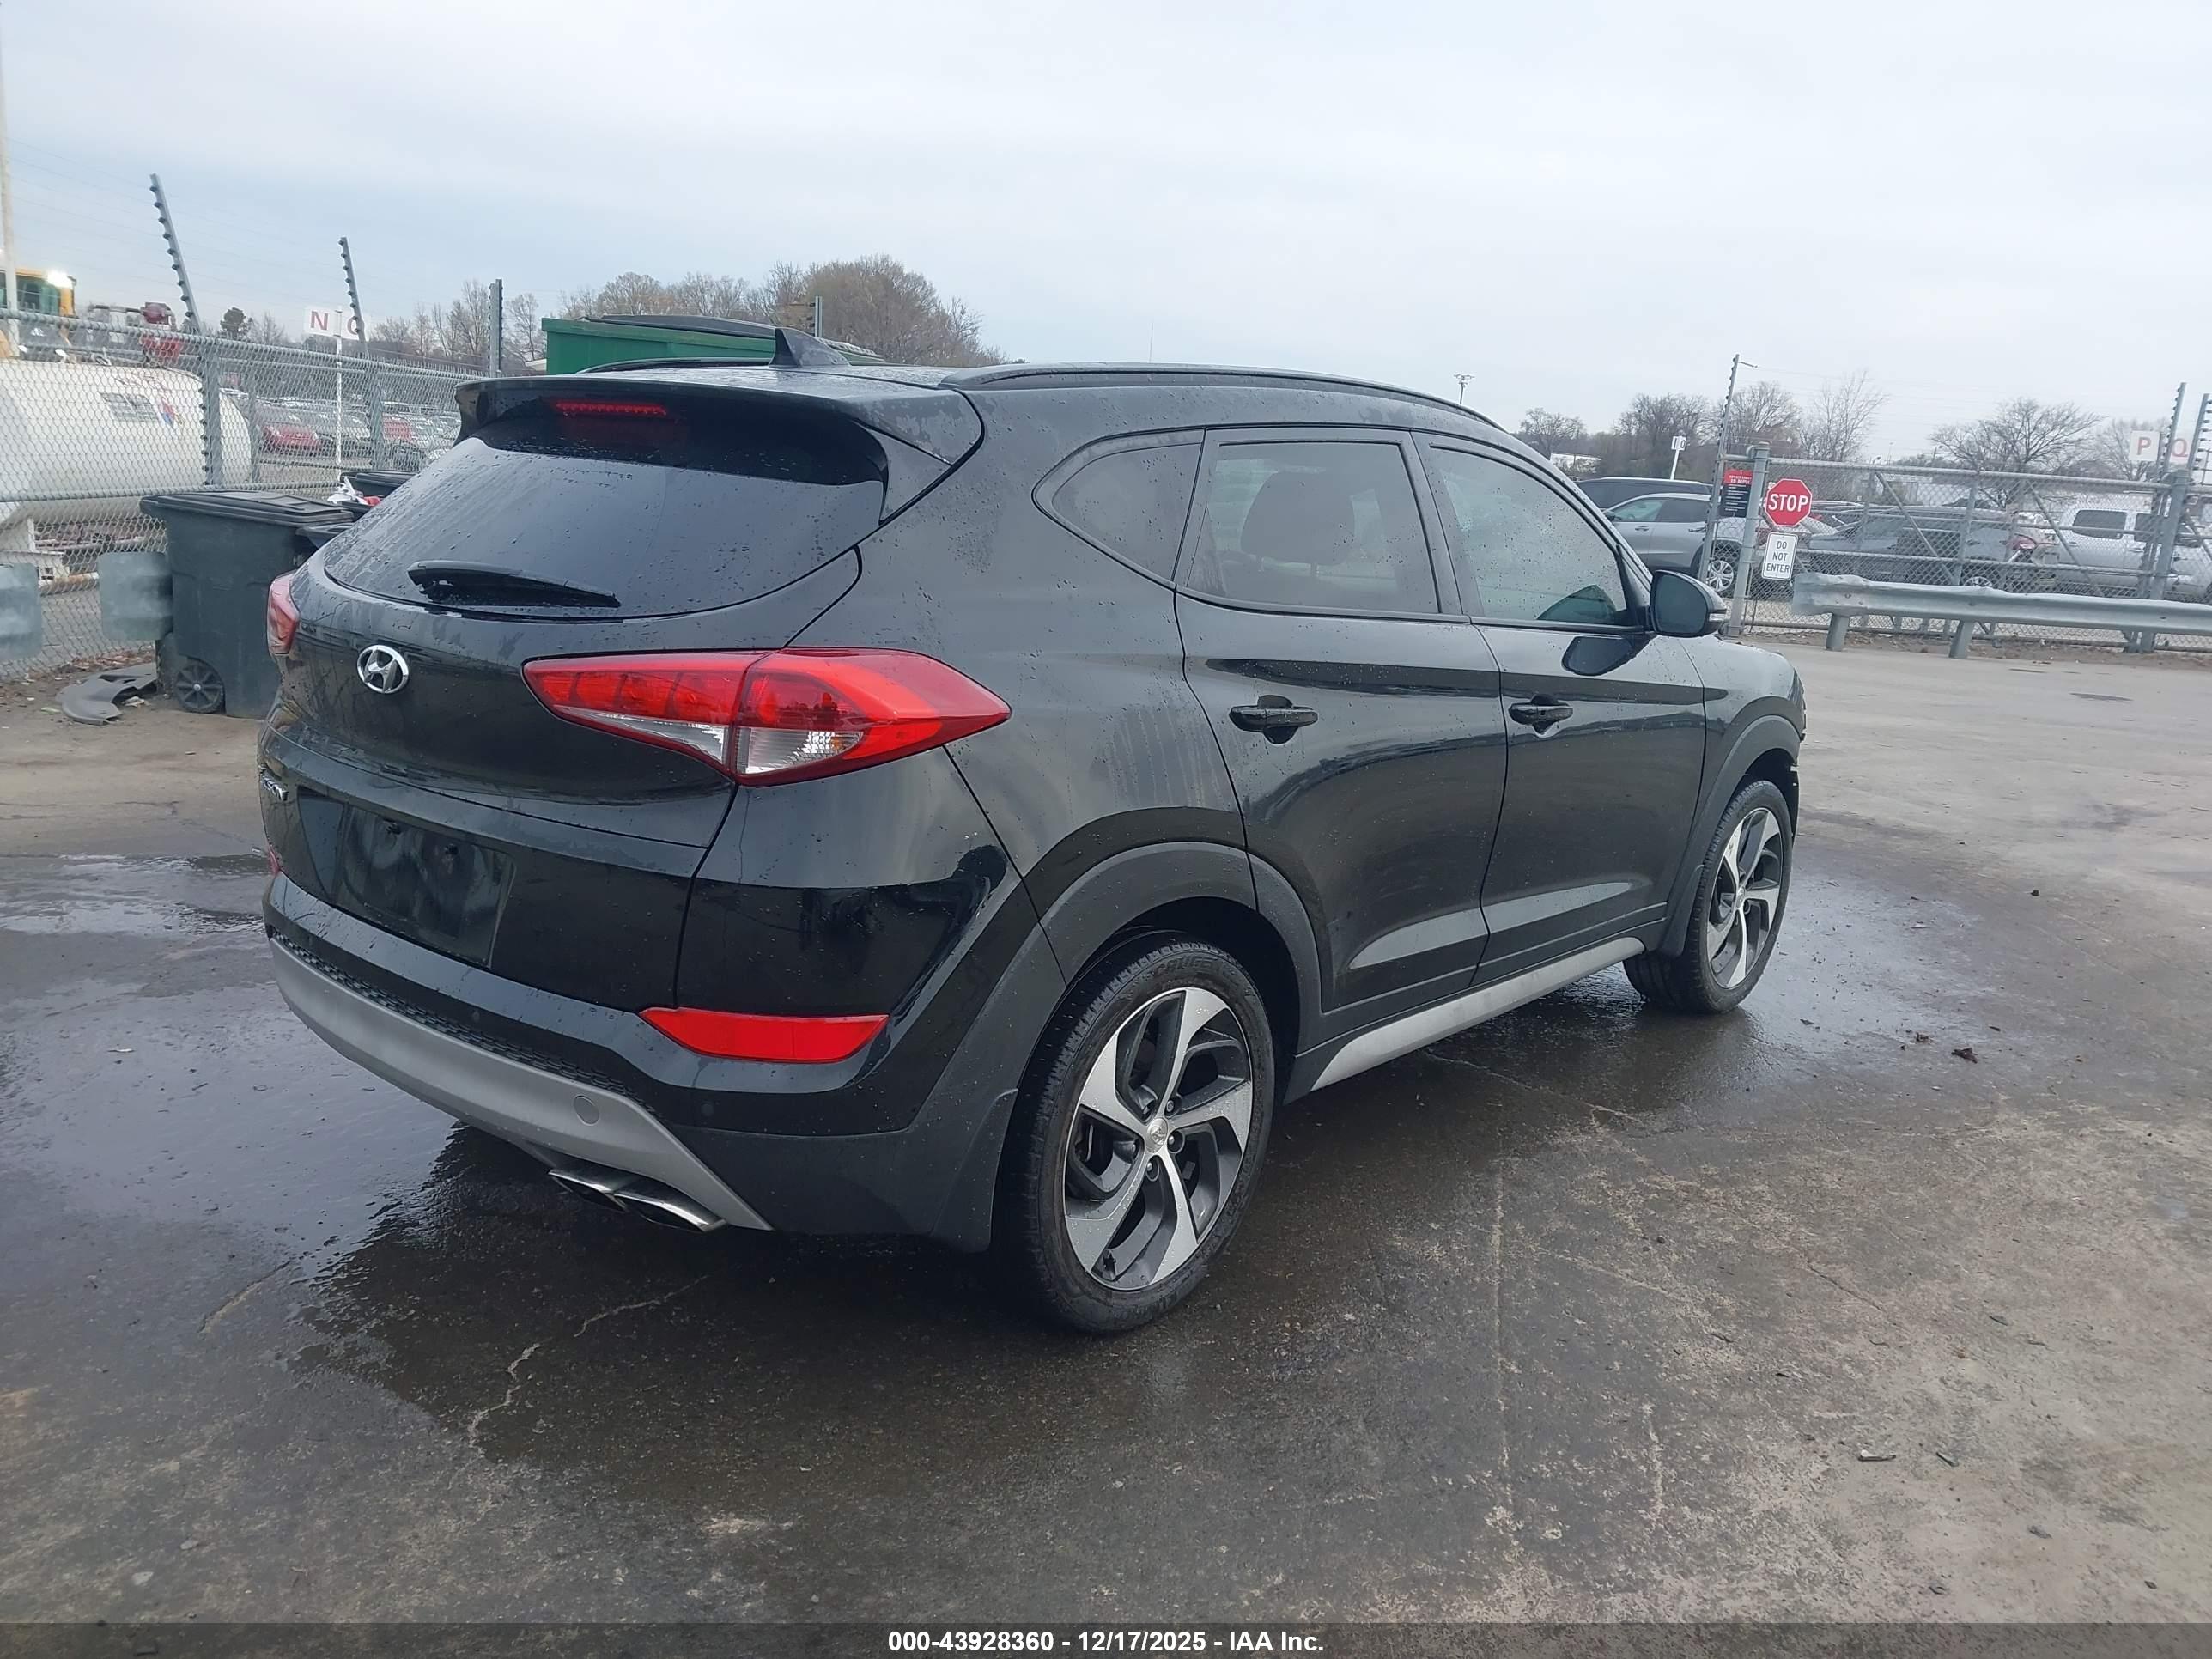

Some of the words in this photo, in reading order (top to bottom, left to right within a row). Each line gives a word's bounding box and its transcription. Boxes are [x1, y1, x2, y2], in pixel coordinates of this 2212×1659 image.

[310, 311, 329, 331] N
[2136, 436, 2152, 456] P
[1768, 493, 1808, 513] STOP
[1776, 540, 1788, 550] DO
[1772, 552, 1788, 562] NOT
[1766, 563, 1790, 574] ENTER
